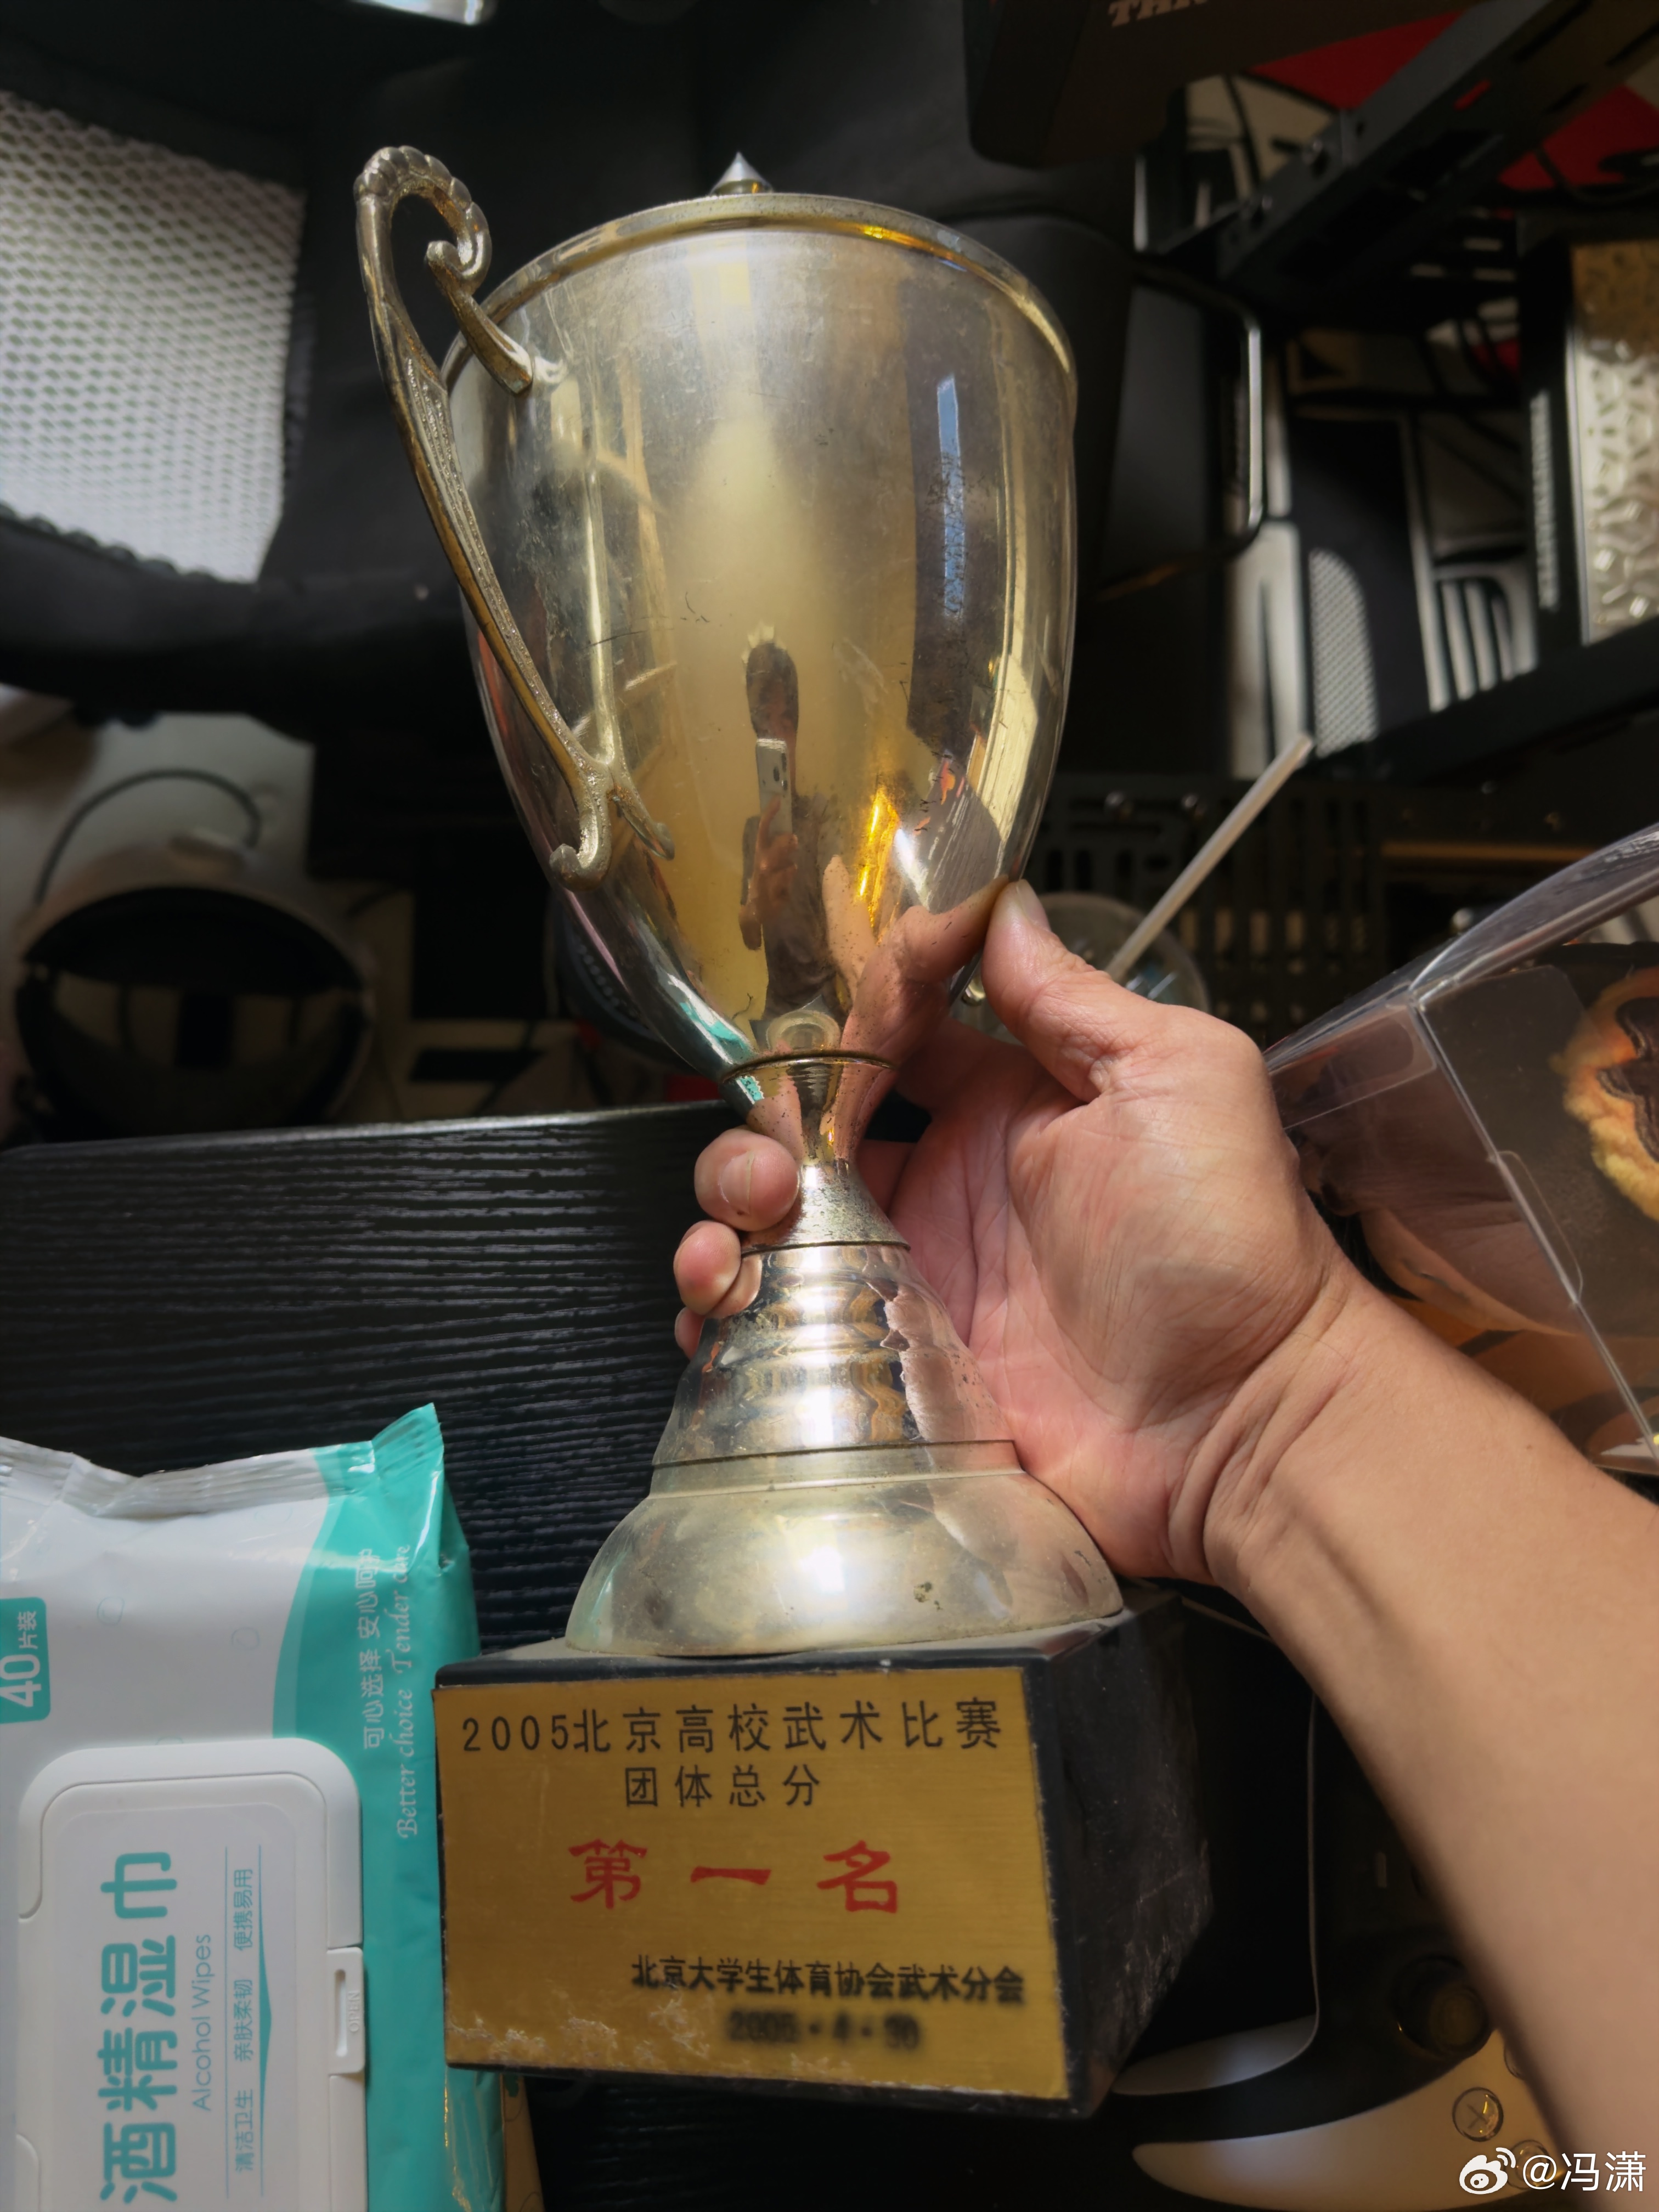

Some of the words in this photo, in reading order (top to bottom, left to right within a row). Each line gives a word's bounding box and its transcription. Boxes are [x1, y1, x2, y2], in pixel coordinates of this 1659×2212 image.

[384, 1590, 413, 1674] Tender
[360, 1648, 385, 1750] 可心选择
[389, 1689, 415, 1758] choice
[462, 1696, 1002, 1754] 2005北京高校武术比赛
[396, 1762, 418, 1838] Better
[624, 1763, 822, 1808] 团体总分
[233, 1868, 254, 1952] 便携易用
[567, 1838, 899, 1914] 第一名
[191, 1934, 216, 2009] Wipes
[631, 1954, 1025, 2006] 北京大学生体育协会武术分会
[97, 1851, 178, 2204] 酒精湿巾
[233, 1978, 254, 2063] 亲肤柔韧
[348, 1990, 360, 2035] OPEN
[191, 2013, 212, 2112] Alcohol
[234, 2089, 255, 2174] 清洁卫生
